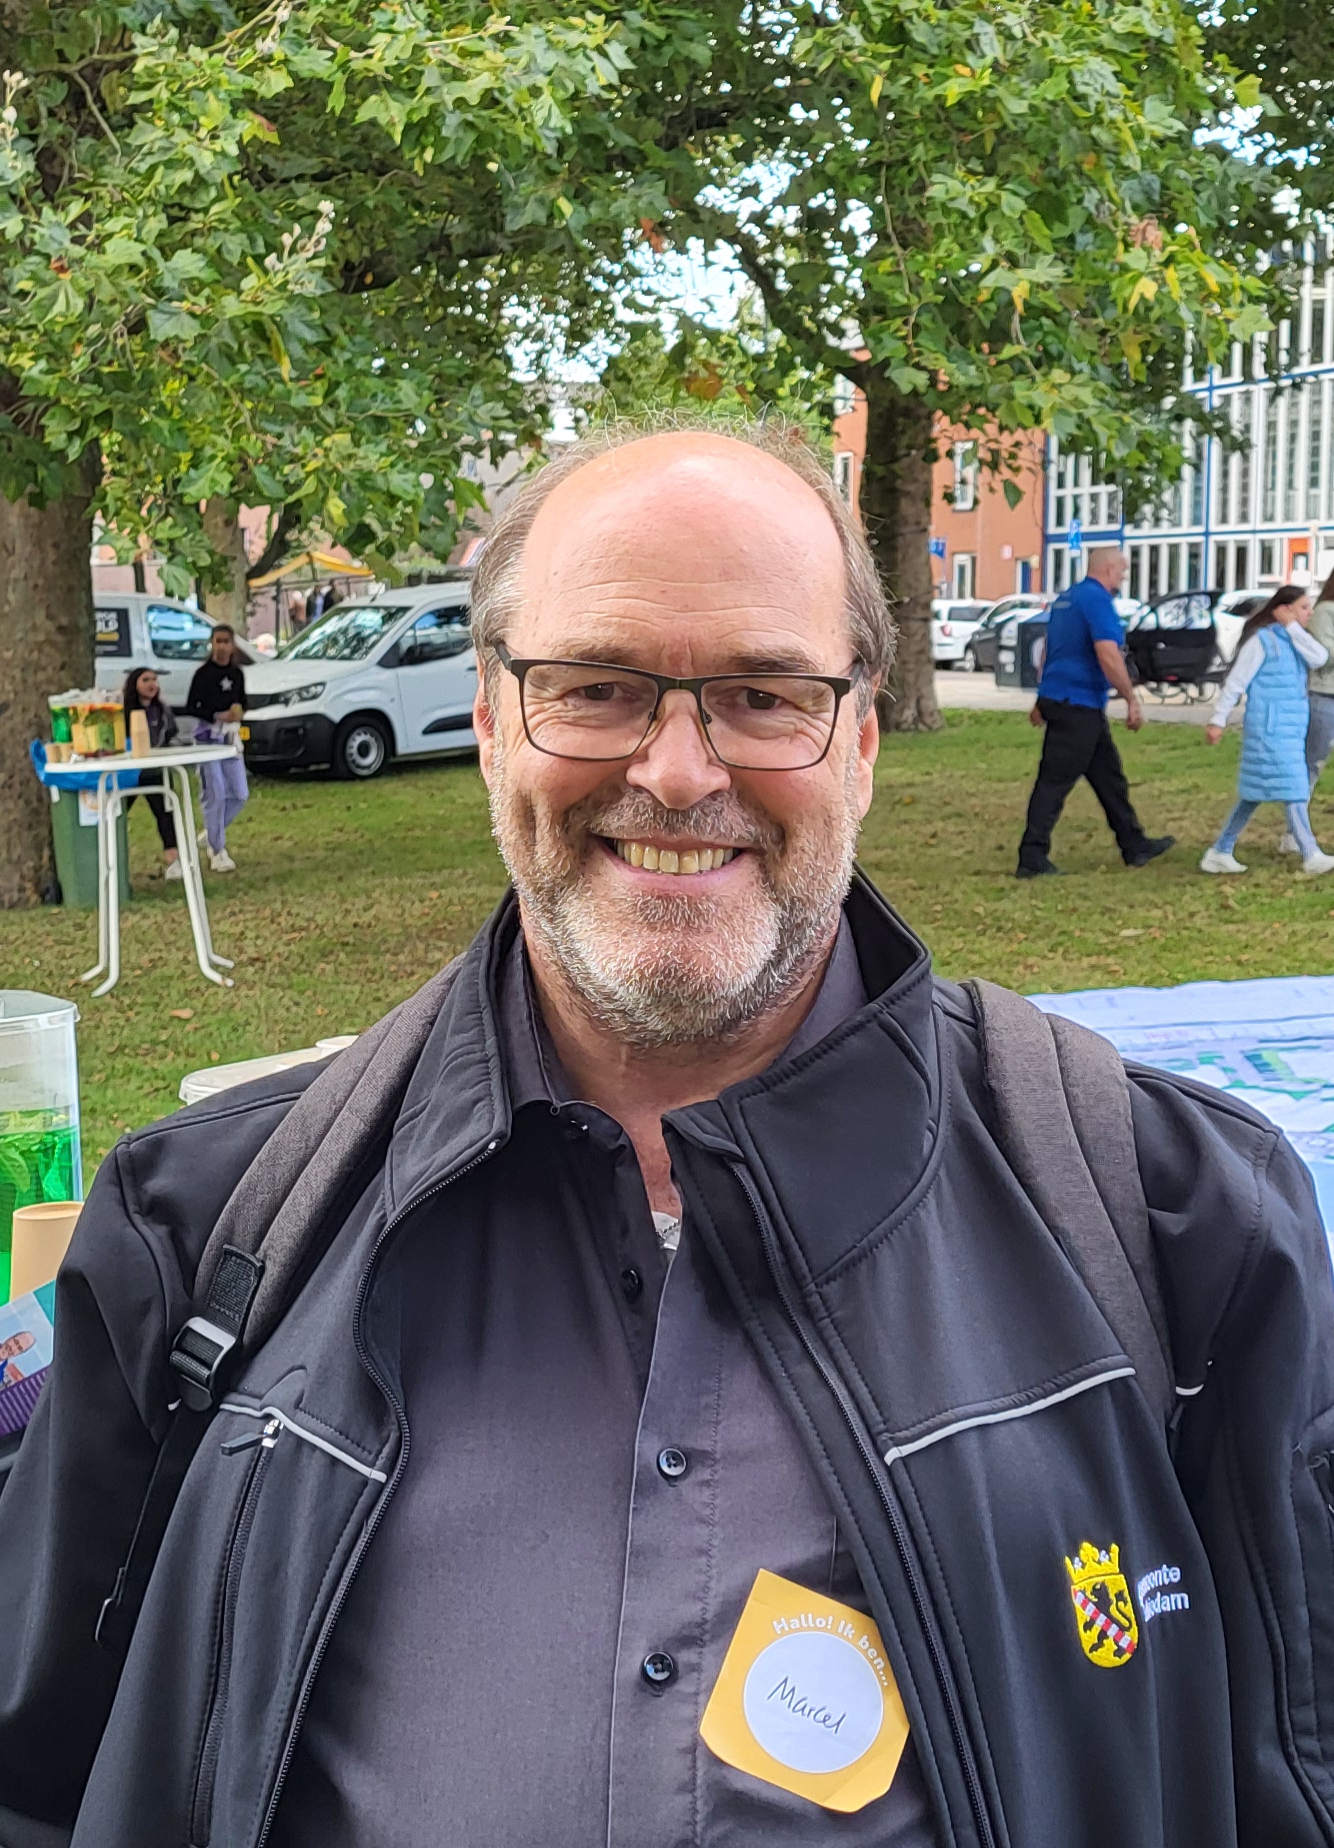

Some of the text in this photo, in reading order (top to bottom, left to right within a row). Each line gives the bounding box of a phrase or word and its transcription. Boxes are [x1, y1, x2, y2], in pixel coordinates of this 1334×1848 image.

[772, 1613, 834, 1635] Hallo!
[837, 1619, 856, 1639] Ik
[767, 1675, 847, 1735] Marcel
